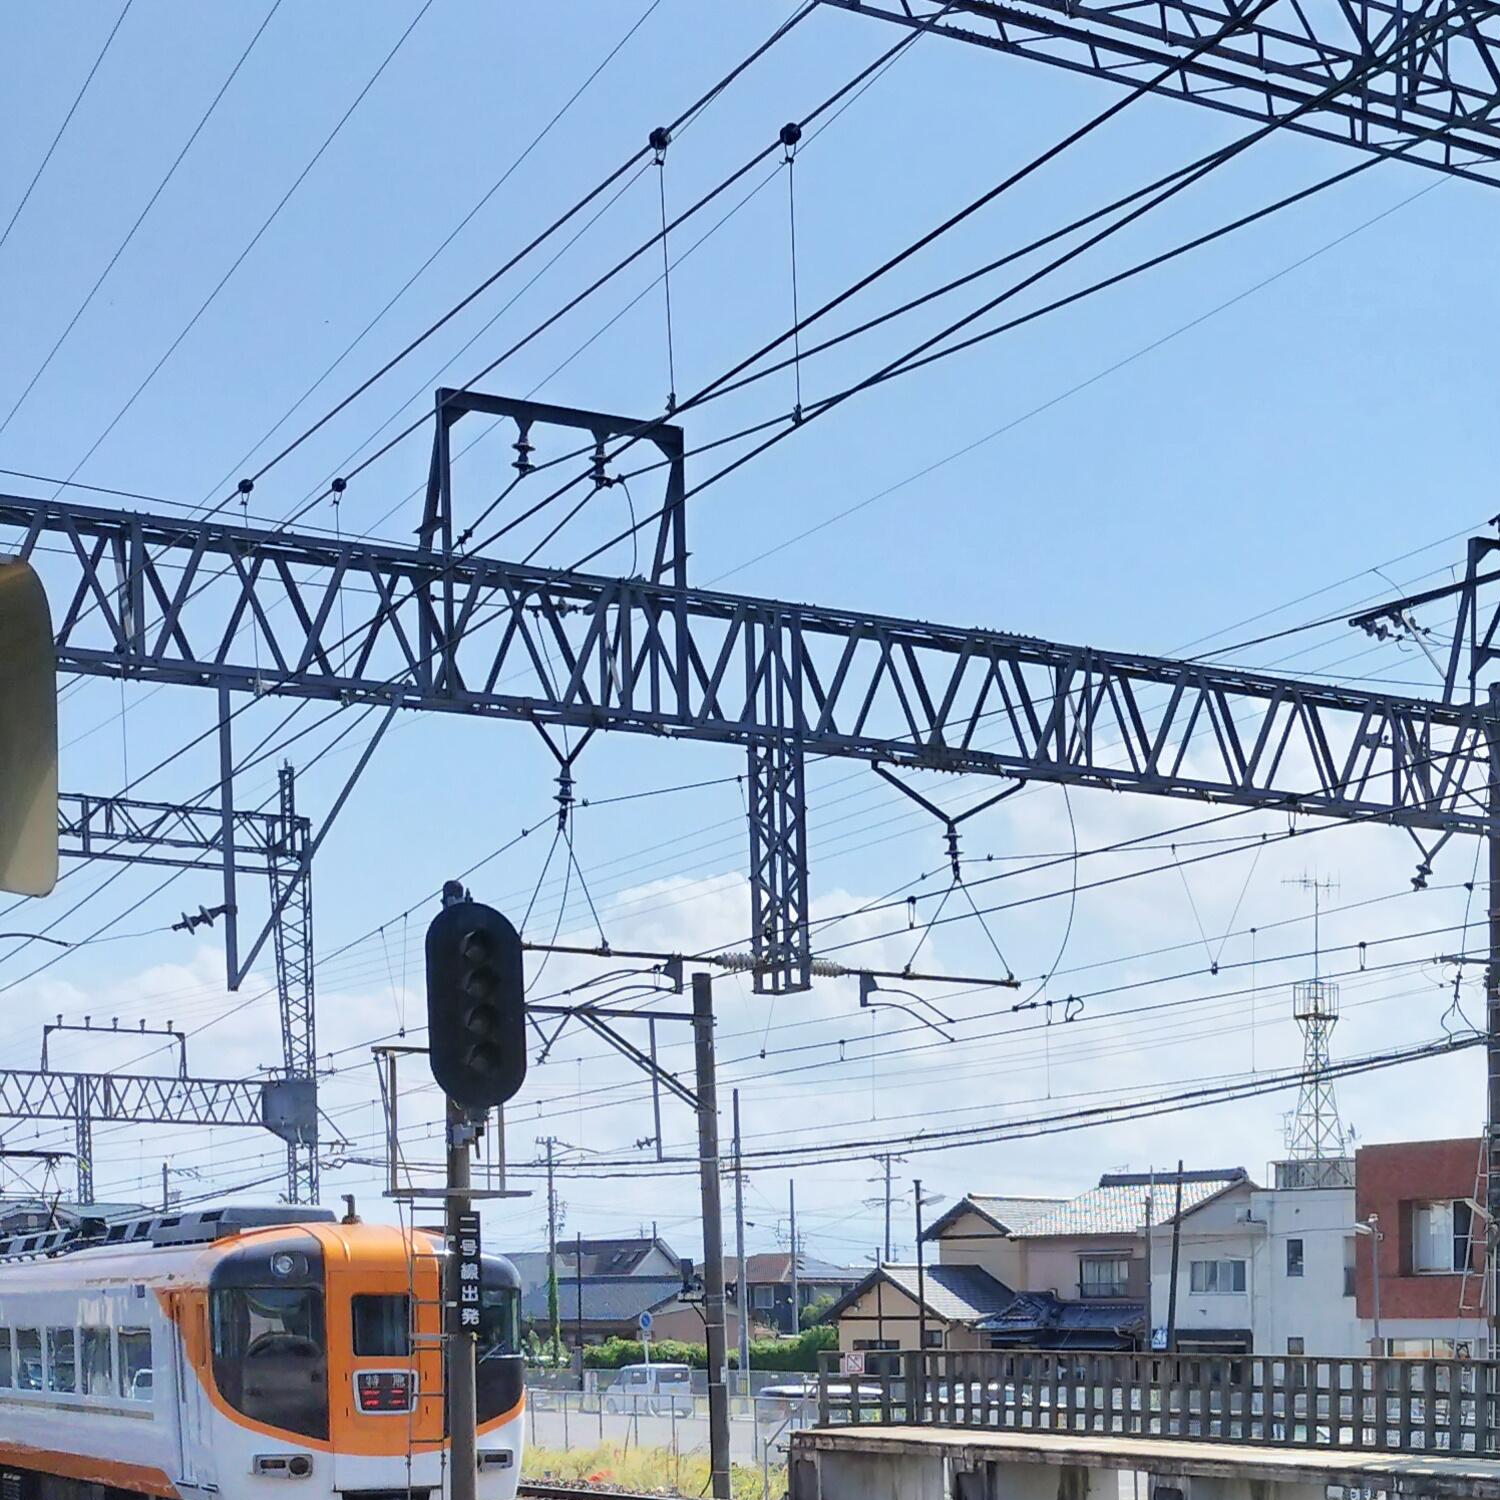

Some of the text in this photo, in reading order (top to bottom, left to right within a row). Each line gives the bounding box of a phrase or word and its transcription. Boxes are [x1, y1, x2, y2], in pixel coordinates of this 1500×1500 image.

[459, 1216, 480, 1326] 二号線出発
